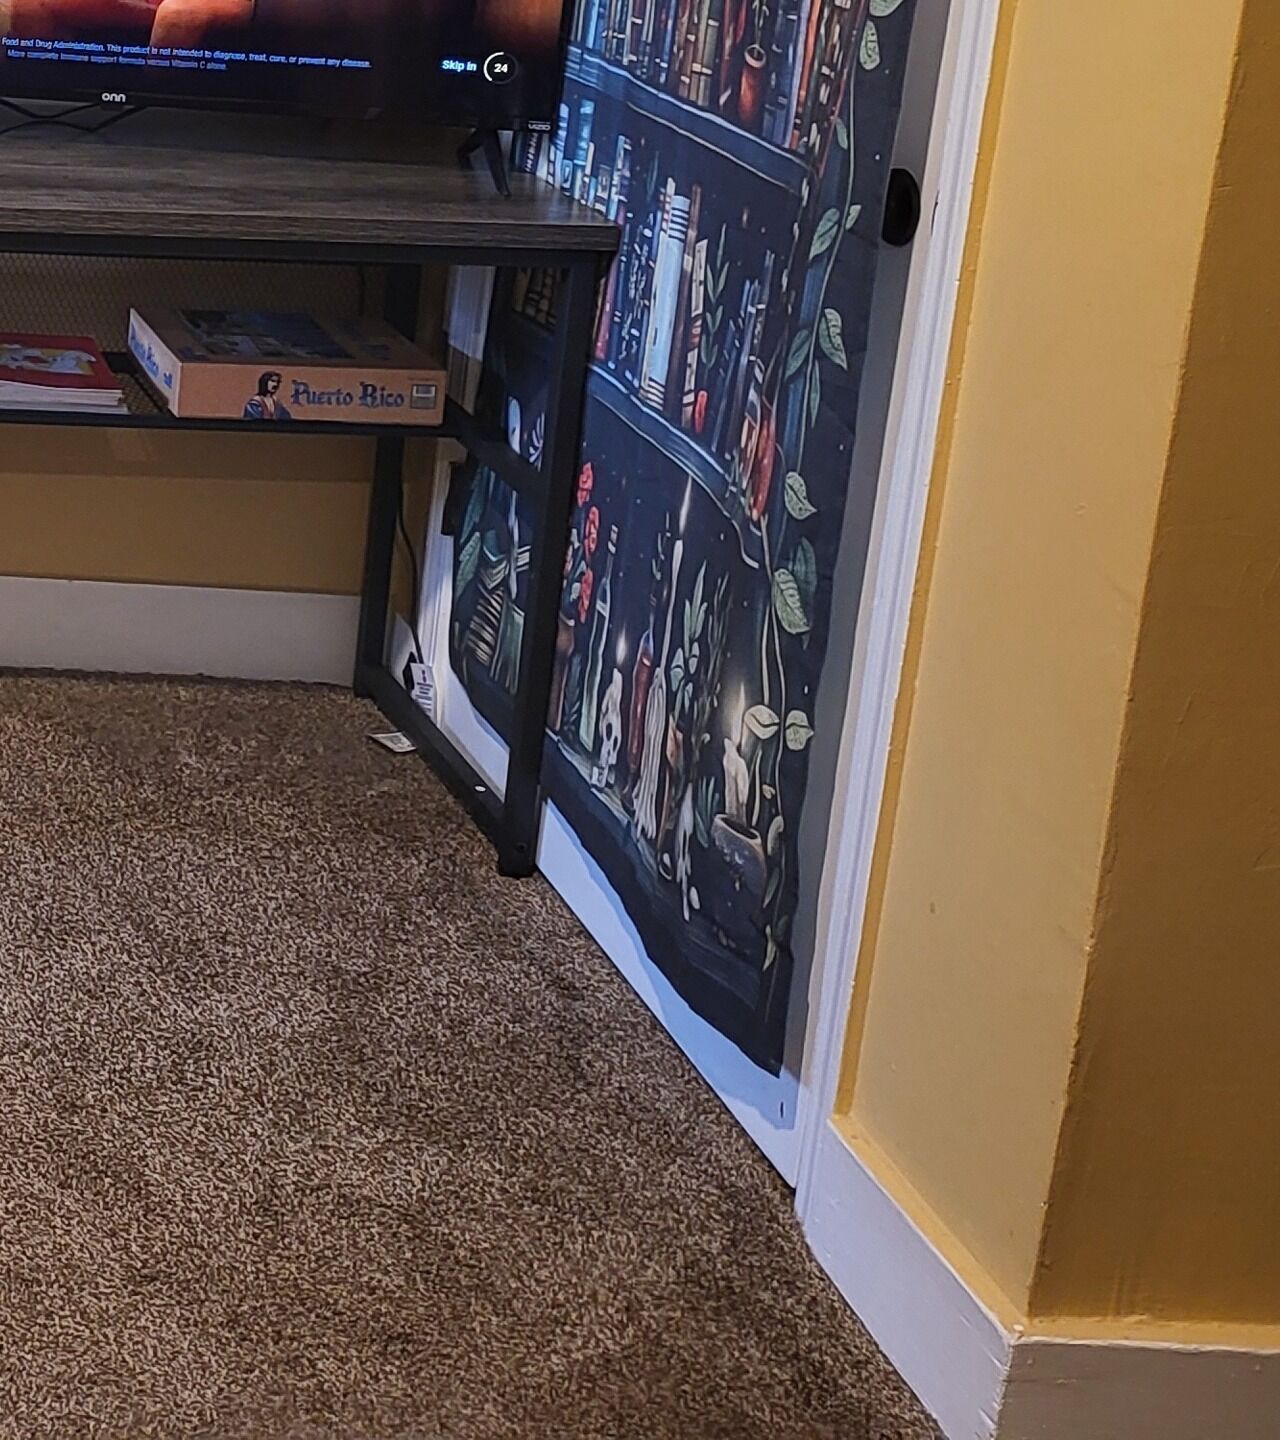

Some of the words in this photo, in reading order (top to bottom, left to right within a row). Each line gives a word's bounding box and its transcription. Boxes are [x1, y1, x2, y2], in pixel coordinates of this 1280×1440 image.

[2, 37, 19, 46] Food
[35, 39, 52, 49] Drug
[106, 44, 122, 53] This
[442, 60, 465, 72] Skip
[494, 63, 508, 73] 24
[101, 92, 126, 103] onn
[290, 379, 354, 407] Puerto
[357, 380, 405, 409] Rico
